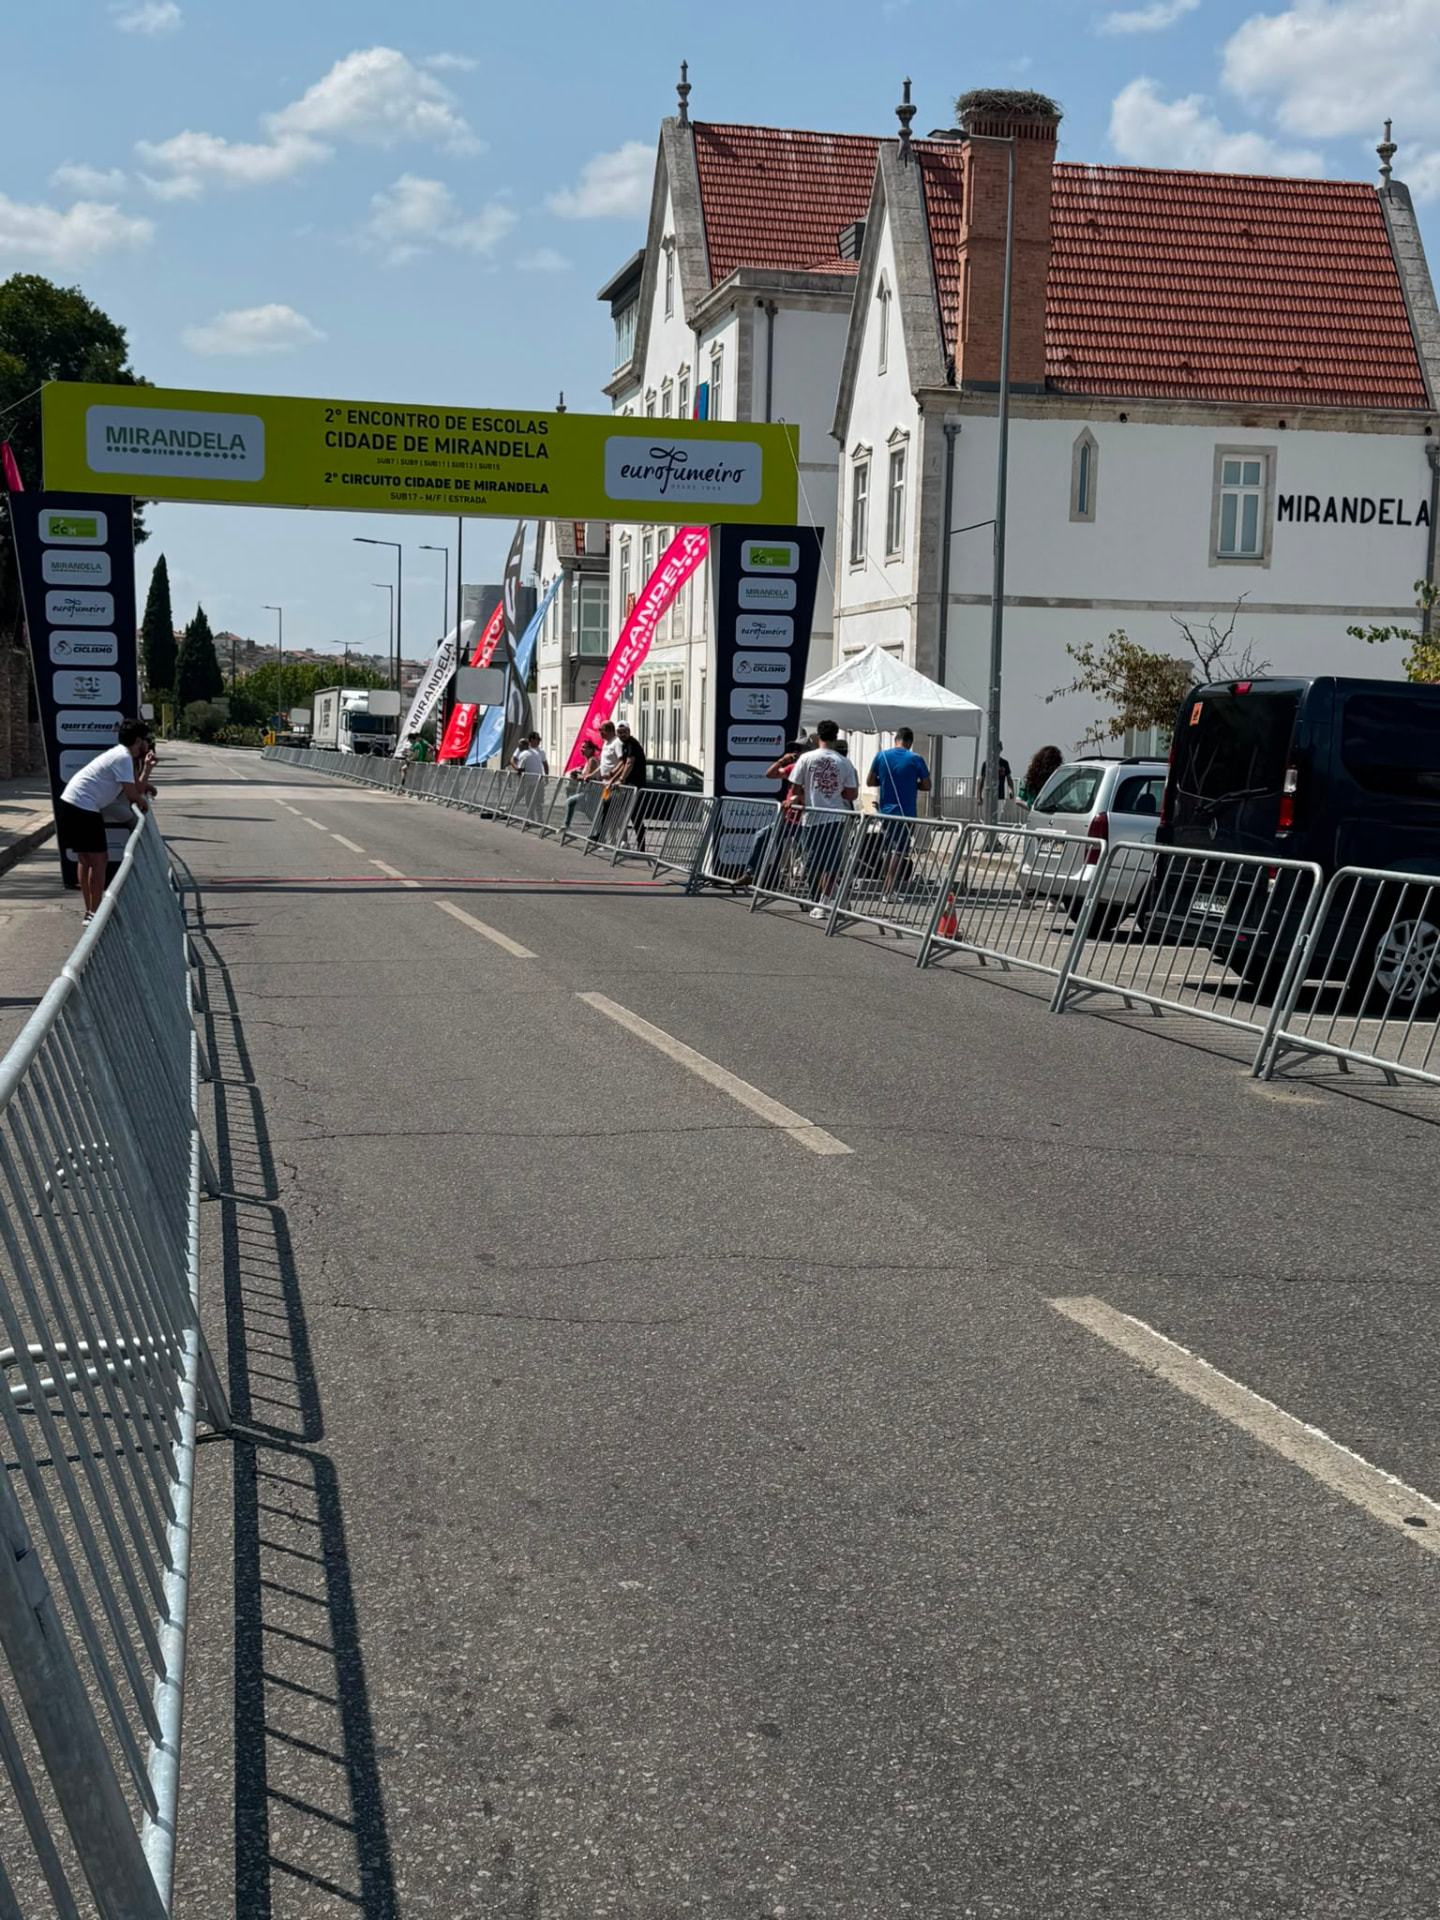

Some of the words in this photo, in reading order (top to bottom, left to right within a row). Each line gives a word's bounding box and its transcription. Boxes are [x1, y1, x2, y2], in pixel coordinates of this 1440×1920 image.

[347, 409, 440, 429] ENCONTRO
[446, 415, 467, 431] DE
[472, 417, 549, 435] ESCOLAS
[105, 425, 246, 453] MIRANDELA
[324, 430, 398, 451] CIDADE
[403, 435, 429, 453] DE
[435, 437, 549, 460] MIRANDELA
[341, 473, 401, 487] CIRCUITO
[404, 476, 452, 490] CIDADE
[454, 479, 471, 491] DE
[474, 480, 549, 494] MIRANDELA
[620, 446, 747, 494] eurofumeiro
[390, 491, 418, 502] SUB17
[425, 493, 442, 503] M/F
[448, 494, 487, 505] ESTRADA
[1277, 494, 1431, 527] MIRANDELA
[603, 532, 704, 703] MIRANDELA
[73, 646, 113, 654] CICLISMO
[409, 642, 455, 729] MIRANDELA
